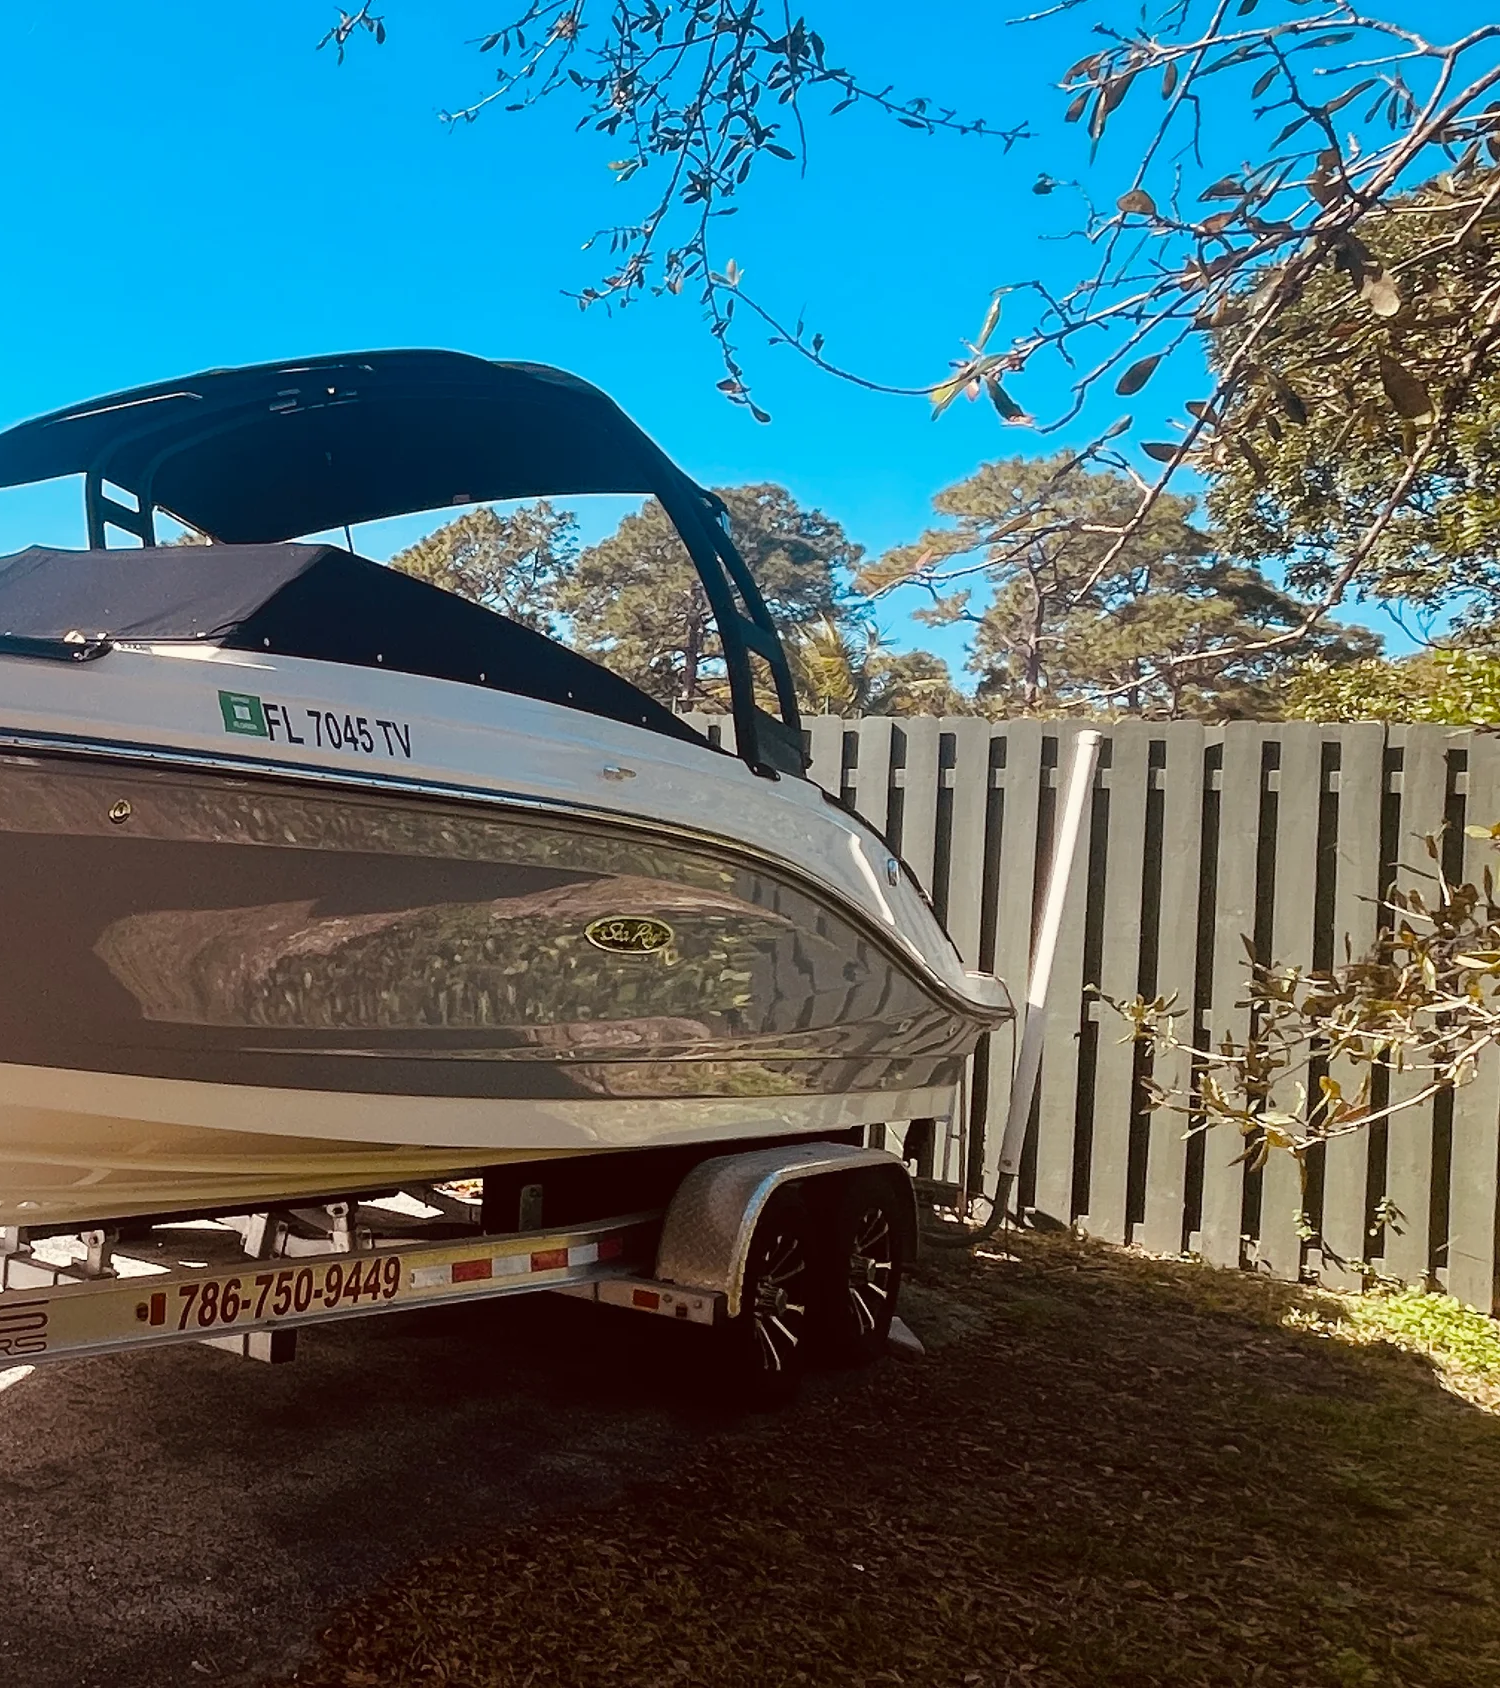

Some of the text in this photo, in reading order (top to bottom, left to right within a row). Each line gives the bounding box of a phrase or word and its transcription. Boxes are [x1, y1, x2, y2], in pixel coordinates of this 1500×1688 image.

[262, 702, 412, 759] FL 7045 TV
[177, 1256, 402, 1331] 786-750-9449
